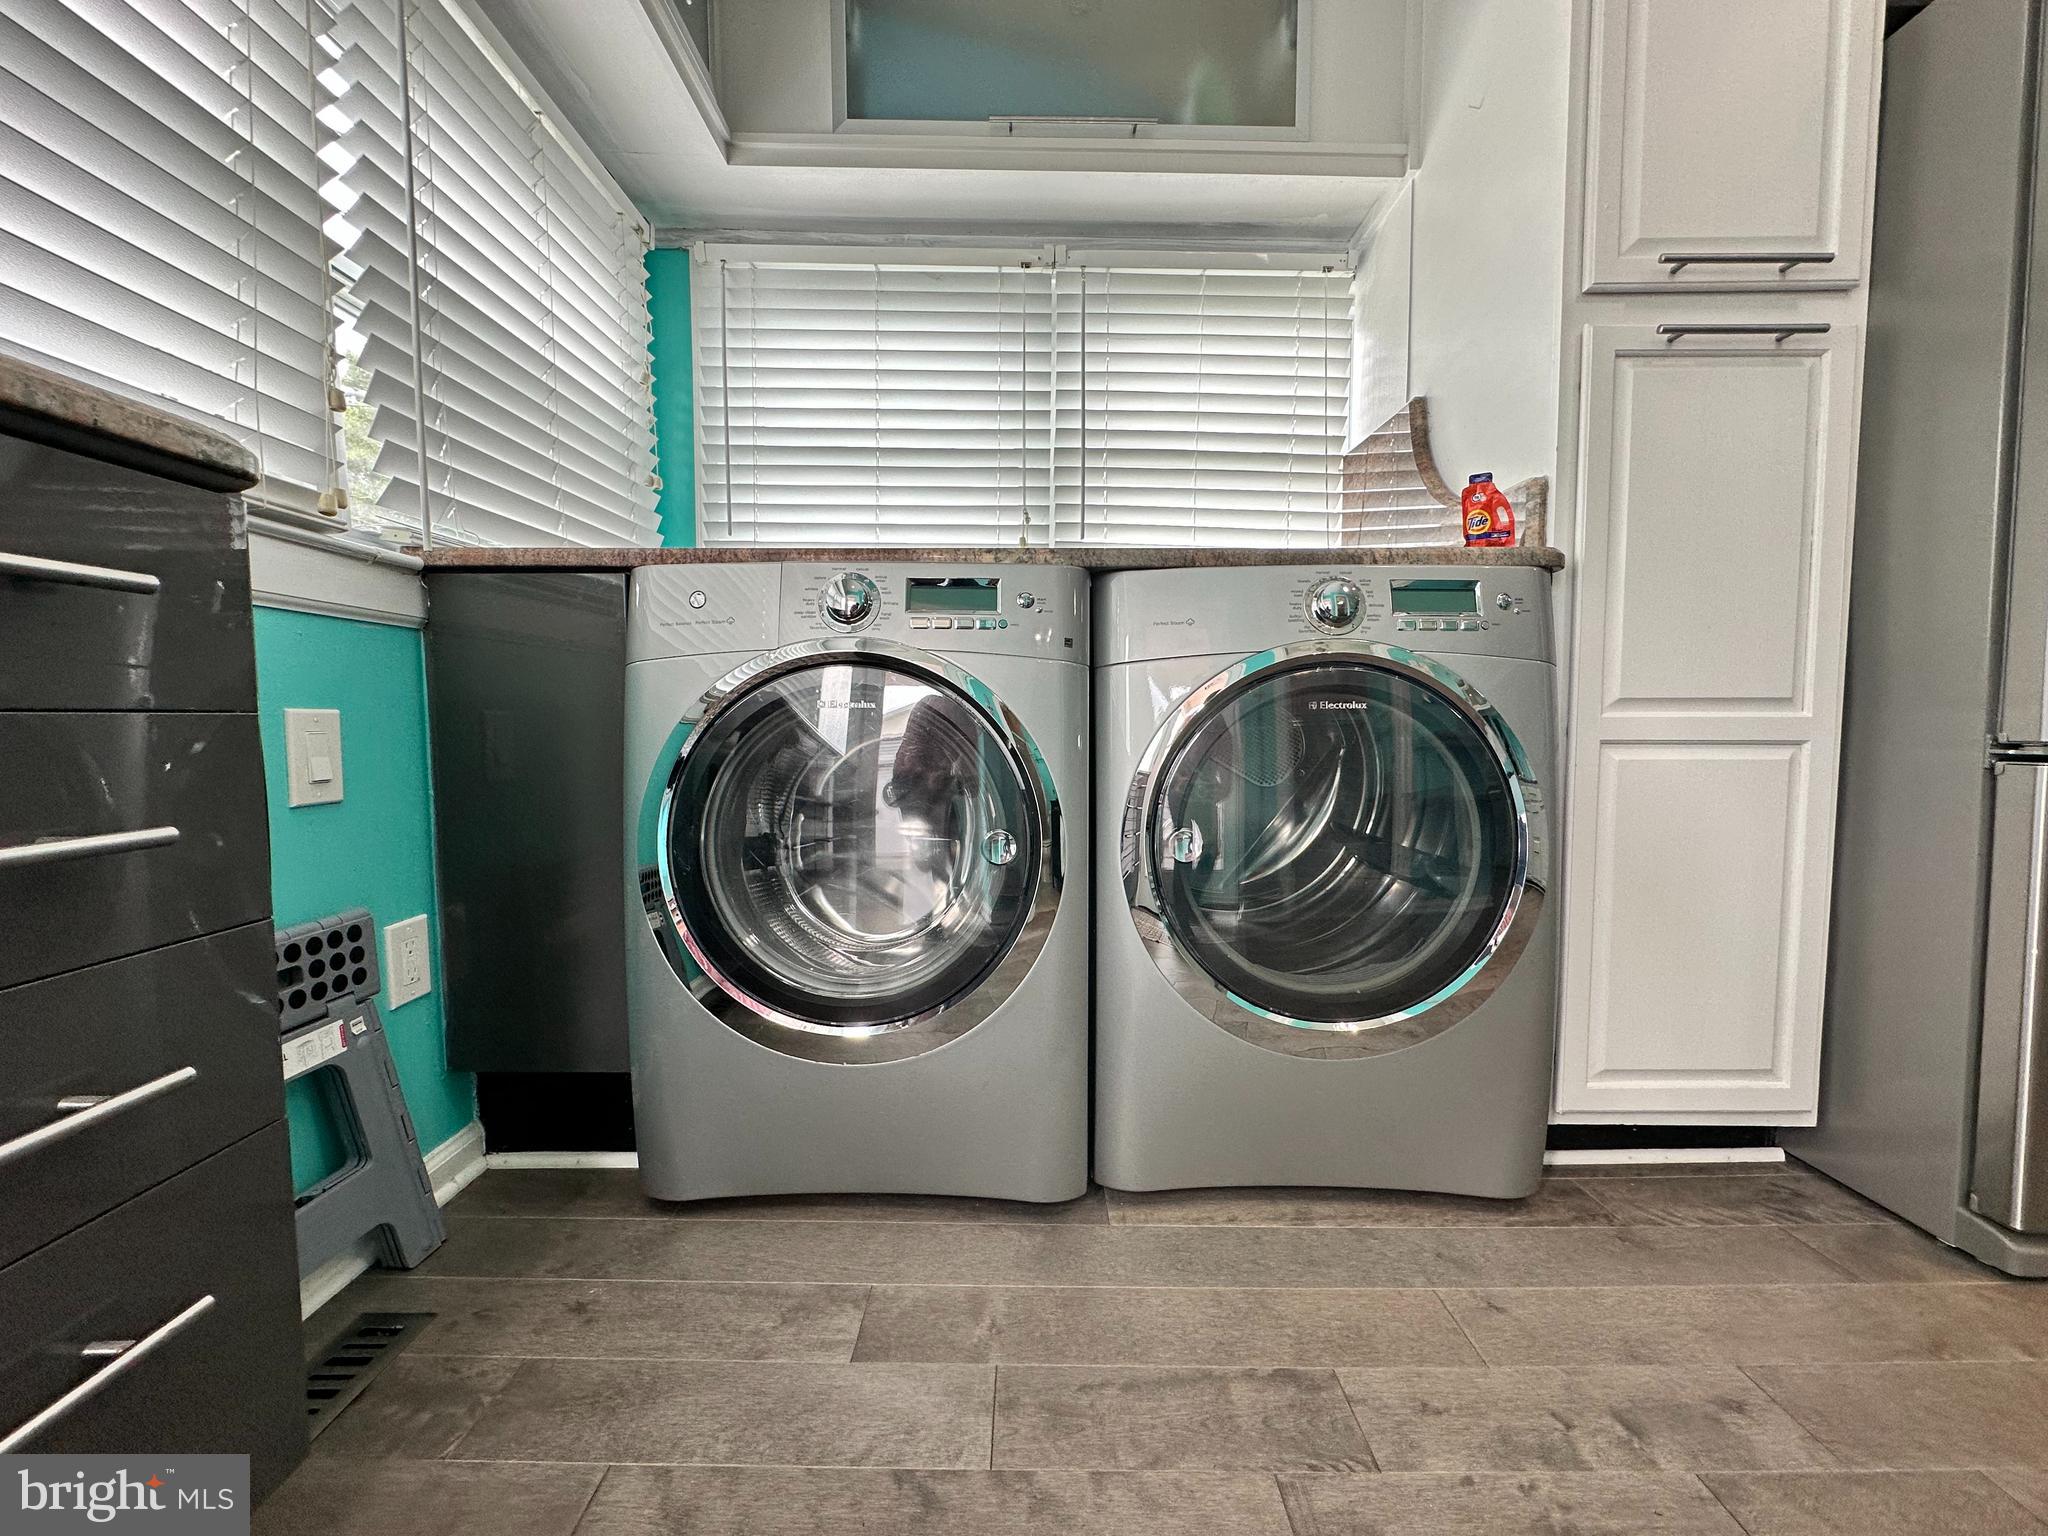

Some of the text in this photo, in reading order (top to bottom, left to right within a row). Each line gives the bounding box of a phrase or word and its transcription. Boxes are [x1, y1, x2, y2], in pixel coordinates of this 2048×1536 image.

[1468, 516, 1489, 530] Tide
[829, 699, 877, 709] Electrolux
[1319, 701, 1368, 710] Electrolux
